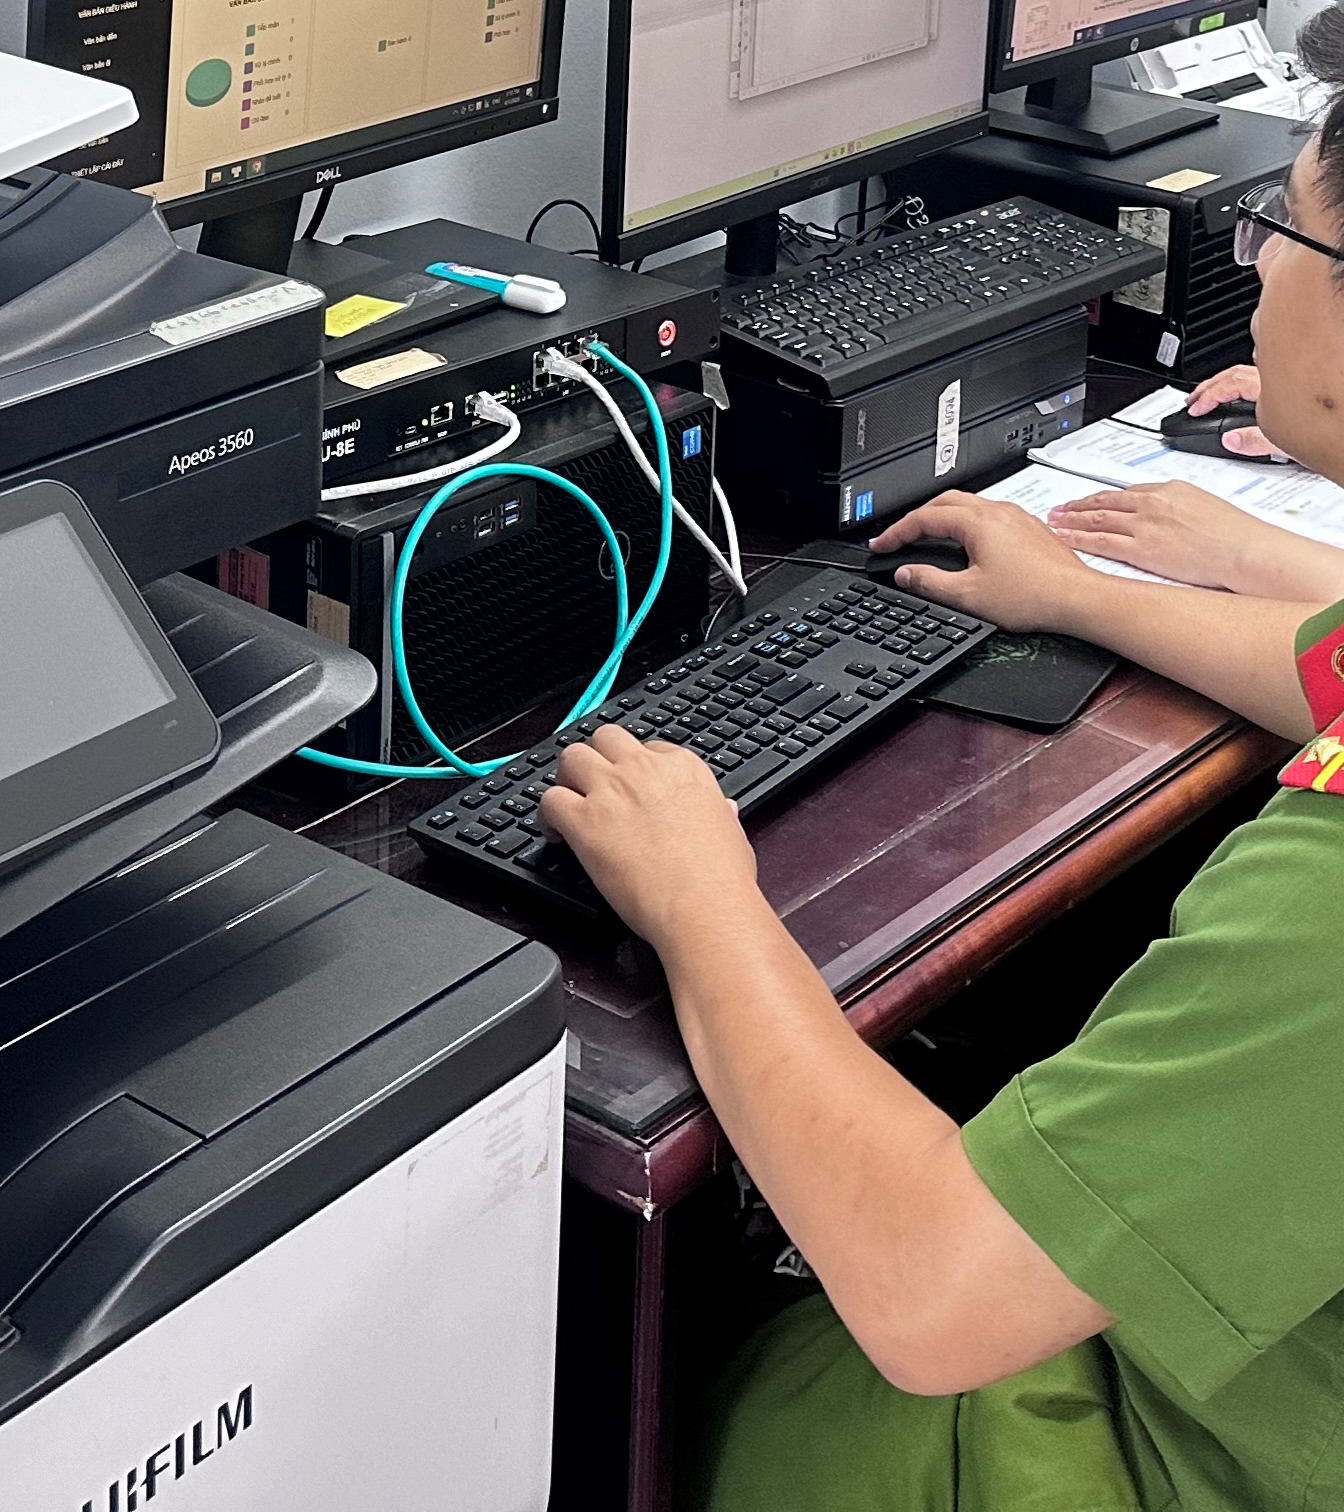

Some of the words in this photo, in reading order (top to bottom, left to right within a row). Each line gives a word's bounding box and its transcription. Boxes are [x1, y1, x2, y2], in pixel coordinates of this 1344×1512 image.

[315, 166, 342, 184] DELL
[168, 445, 215, 475] Apeos
[217, 428, 254, 457] 3560
[857, 409, 867, 451] acer
[82, 1384, 253, 1512] JIFILM
